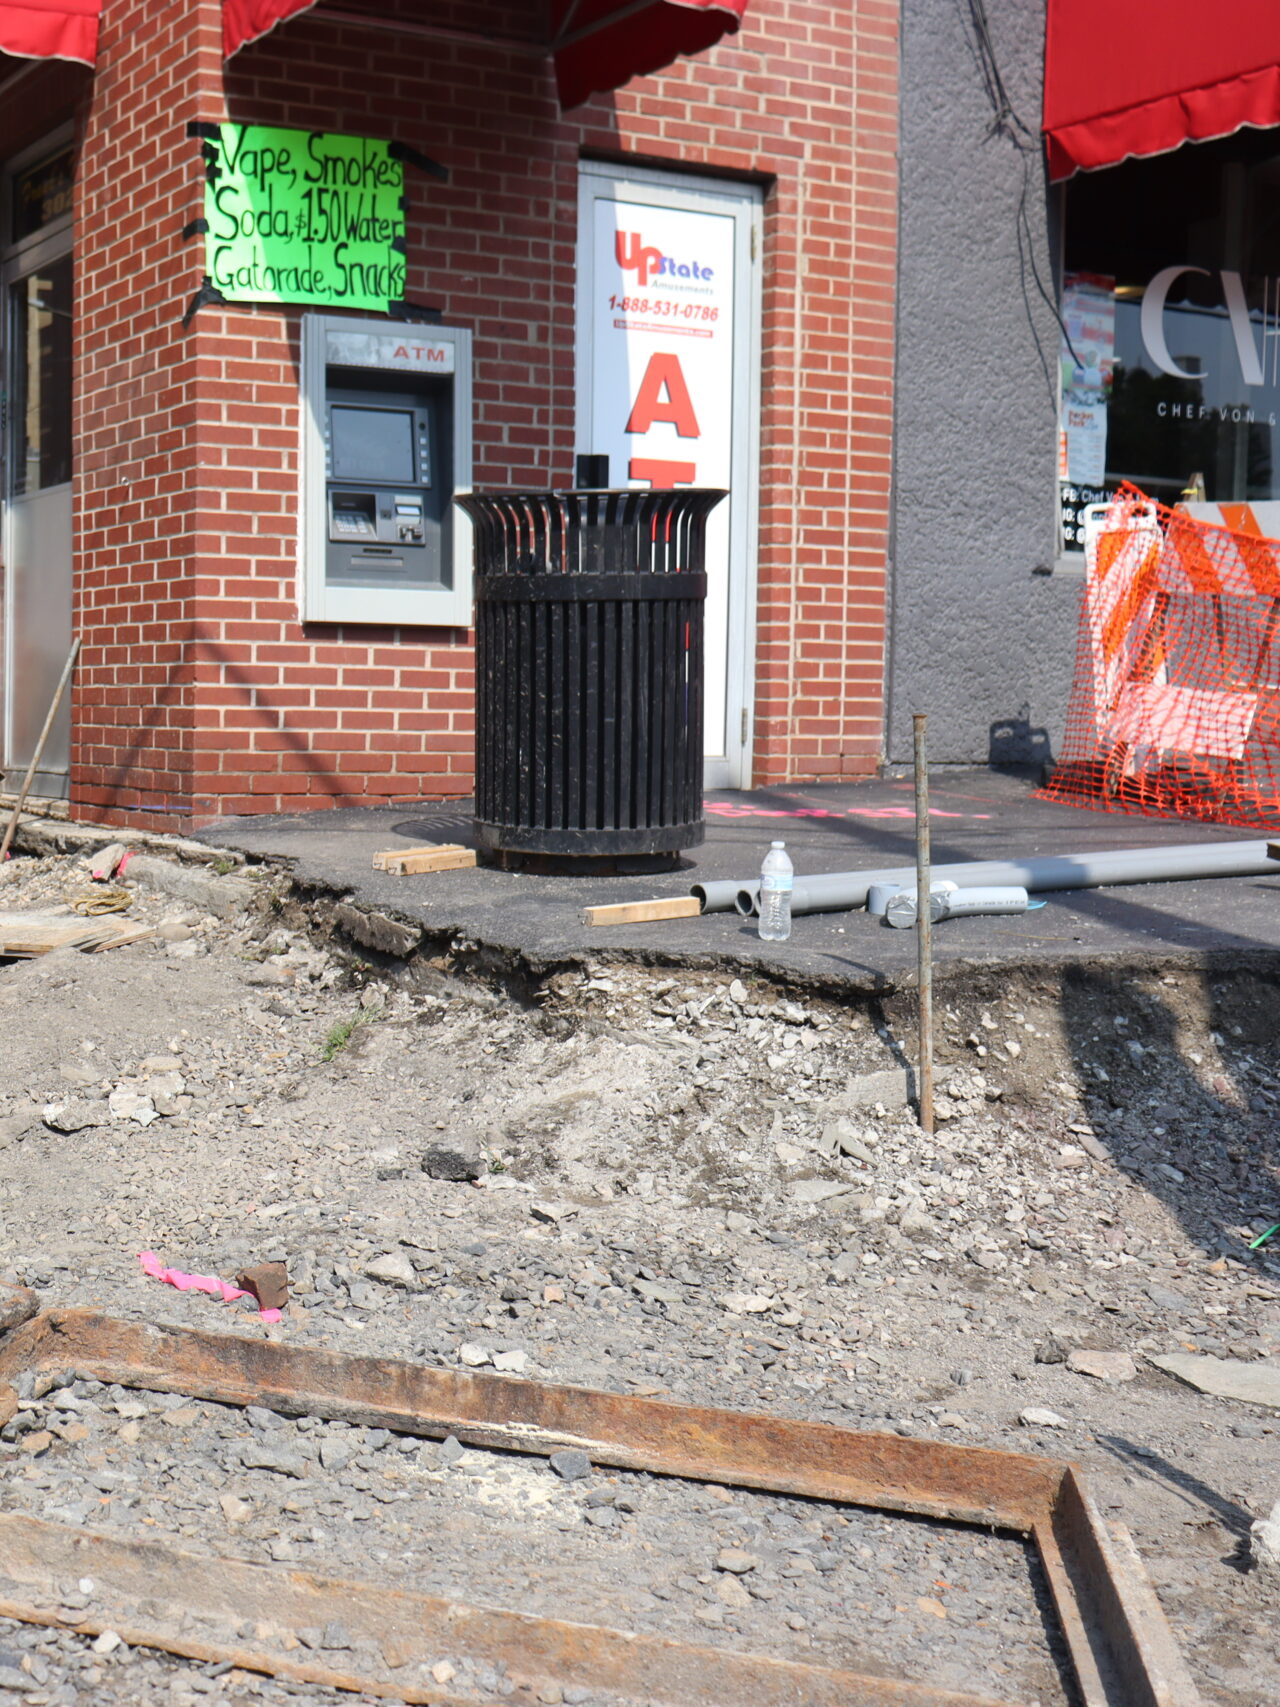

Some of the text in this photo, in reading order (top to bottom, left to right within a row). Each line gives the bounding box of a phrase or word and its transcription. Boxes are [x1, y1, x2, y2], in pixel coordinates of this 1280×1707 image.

[220, 125, 402, 192] Vape, Smokes
[214, 183, 294, 244] Soda,
[344, 190, 404, 243] Water
[214, 242, 406, 300] Gatorade, Snacks
[608, 294, 719, 321] 1-888-531-0786
[393, 345, 445, 362] ATM
[1157, 402, 1207, 420] CHEF
[1220, 408, 1255, 424] VON
